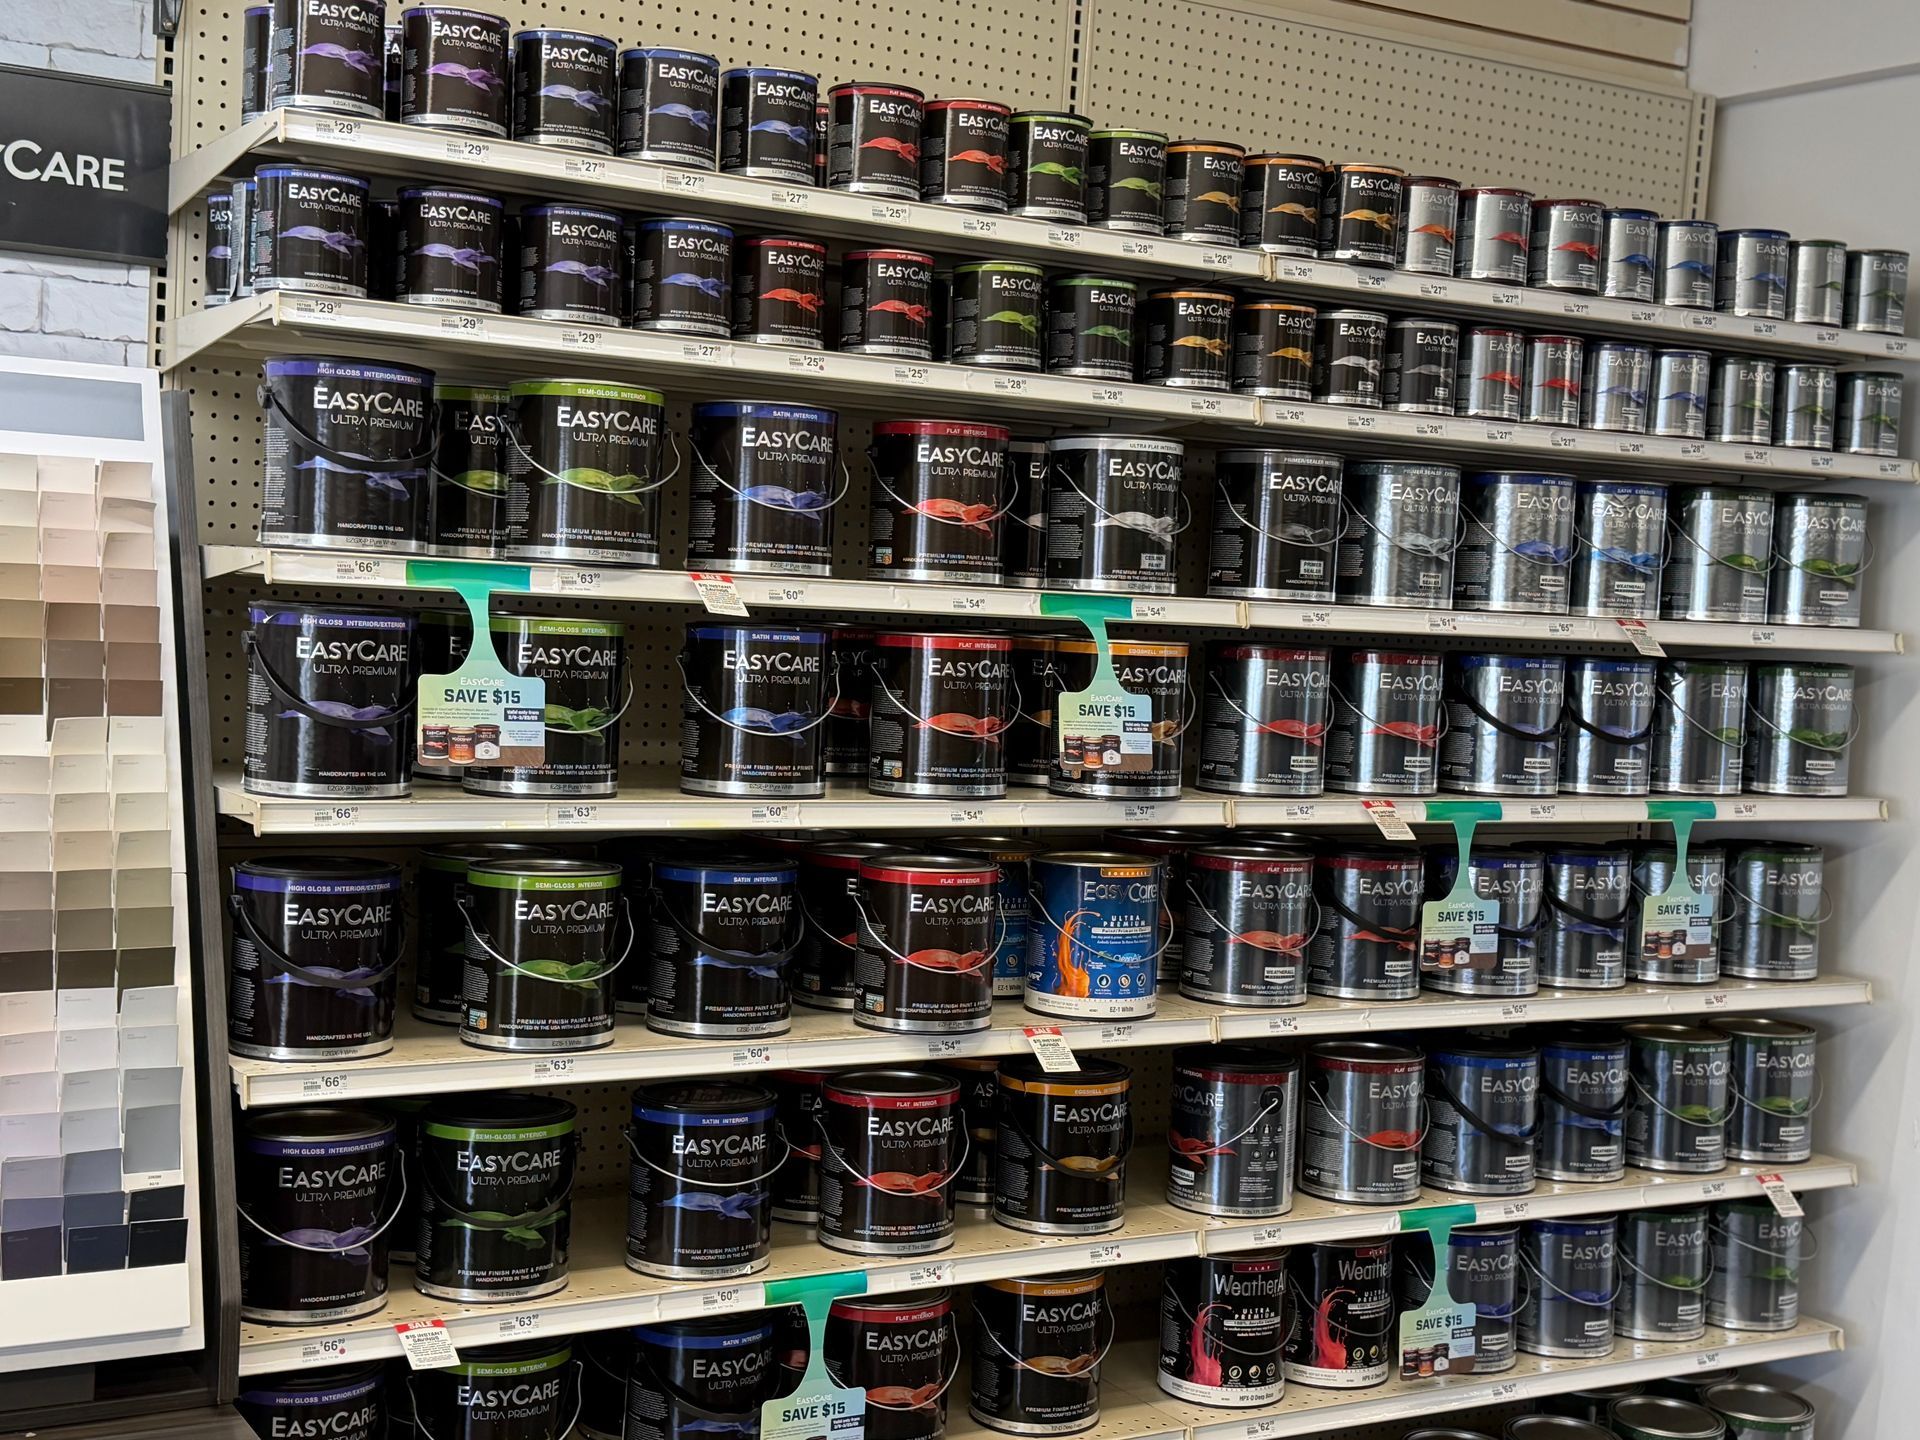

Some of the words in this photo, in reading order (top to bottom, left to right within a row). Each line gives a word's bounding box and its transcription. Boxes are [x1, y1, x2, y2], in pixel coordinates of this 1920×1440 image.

[309, 0, 379, 27] EASYCARE
[431, 22, 501, 46] EASYCARE
[542, 45, 609, 68] EASYCARE
[659, 64, 716, 89] EASYCARE
[758, 82, 814, 104] EASYCARE
[0, 139, 125, 191] CARE
[289, 184, 361, 207] EASYCARE
[421, 204, 490, 224] EASYCARE
[551, 221, 617, 243] EASYCARE
[668, 236, 729, 256] EASYCARE
[768, 252, 823, 269] EASYCARE
[878, 264, 931, 282] EASYCARE
[1179, 302, 1231, 318] EASYCARE
[364, 371, 421, 384] INTERIOR/EXTERIOR
[314, 387, 424, 418] EASYCARE
[578, 388, 618, 397] SEMI-GLOSS
[621, 392, 645, 400] INTERIOR
[331, 415, 367, 426] ULTRA
[370, 417, 413, 430] PREMIUM
[557, 407, 656, 435] EASYCARE
[793, 412, 818, 420] INTERIOR
[573, 433, 607, 442] ULTRA
[610, 435, 648, 447] PREMIUM
[742, 427, 832, 453] EASYCARE
[917, 444, 1003, 467] EASYCARE
[346, 620, 405, 629] INTERIOR/EXTERIOR
[296, 637, 407, 662] EASYCARE
[518, 644, 617, 667] EASYCARE
[314, 664, 349, 674] ULTRA
[353, 664, 396, 676] PREMIUM
[724, 651, 819, 672] EASYCARE
[929, 658, 1010, 678] EASYCARE
[737, 674, 769, 683] ULTRA
[771, 675, 810, 685] PREMIUM
[445, 689, 486, 703] SAVE
[492, 689, 520, 704] $15
[1079, 704, 1109, 717] SAVE
[1115, 705, 1134, 718] $15
[334, 883, 390, 892] INTERIOR/EXTERIOR
[515, 900, 613, 920] EASYCARE
[703, 893, 792, 913] EASYCARE
[911, 893, 994, 913] EASYCARE
[1658, 904, 1681, 915] SAVE
[1684, 904, 1699, 914] $15
[284, 904, 391, 926] EASYCARE
[1438, 911, 1464, 922] SAVE
[1467, 911, 1484, 922] $15
[476, 1133, 517, 1141] SEMI-GLOSS
[519, 1131, 547, 1139] INTERIOR
[868, 1116, 953, 1137] EASYCARE
[328, 1141, 384, 1153] INTERIOR/EXTERIOR
[673, 1134, 766, 1155] EASYCARE
[457, 1150, 560, 1172] EASYCARE
[279, 1162, 385, 1189] EASYCARE
[296, 1192, 331, 1202] ULTRA
[334, 1186, 376, 1199] PREMIUM
[408, 1320, 433, 1329] SALE
[1416, 1318, 1442, 1331] SAVE
[1445, 1315, 1462, 1328] $15
[866, 1326, 947, 1351] EASYCARE
[477, 1367, 517, 1375] SEMI-GLOSS
[520, 1363, 547, 1372] INTERIOR
[322, 1383, 375, 1402] INTERIOR/EXTERIOR
[458, 1380, 559, 1407] EASYCARE
[272, 1404, 376, 1439] EASYCARE
[782, 1406, 817, 1422] SAVE
[822, 1403, 845, 1418] $15
